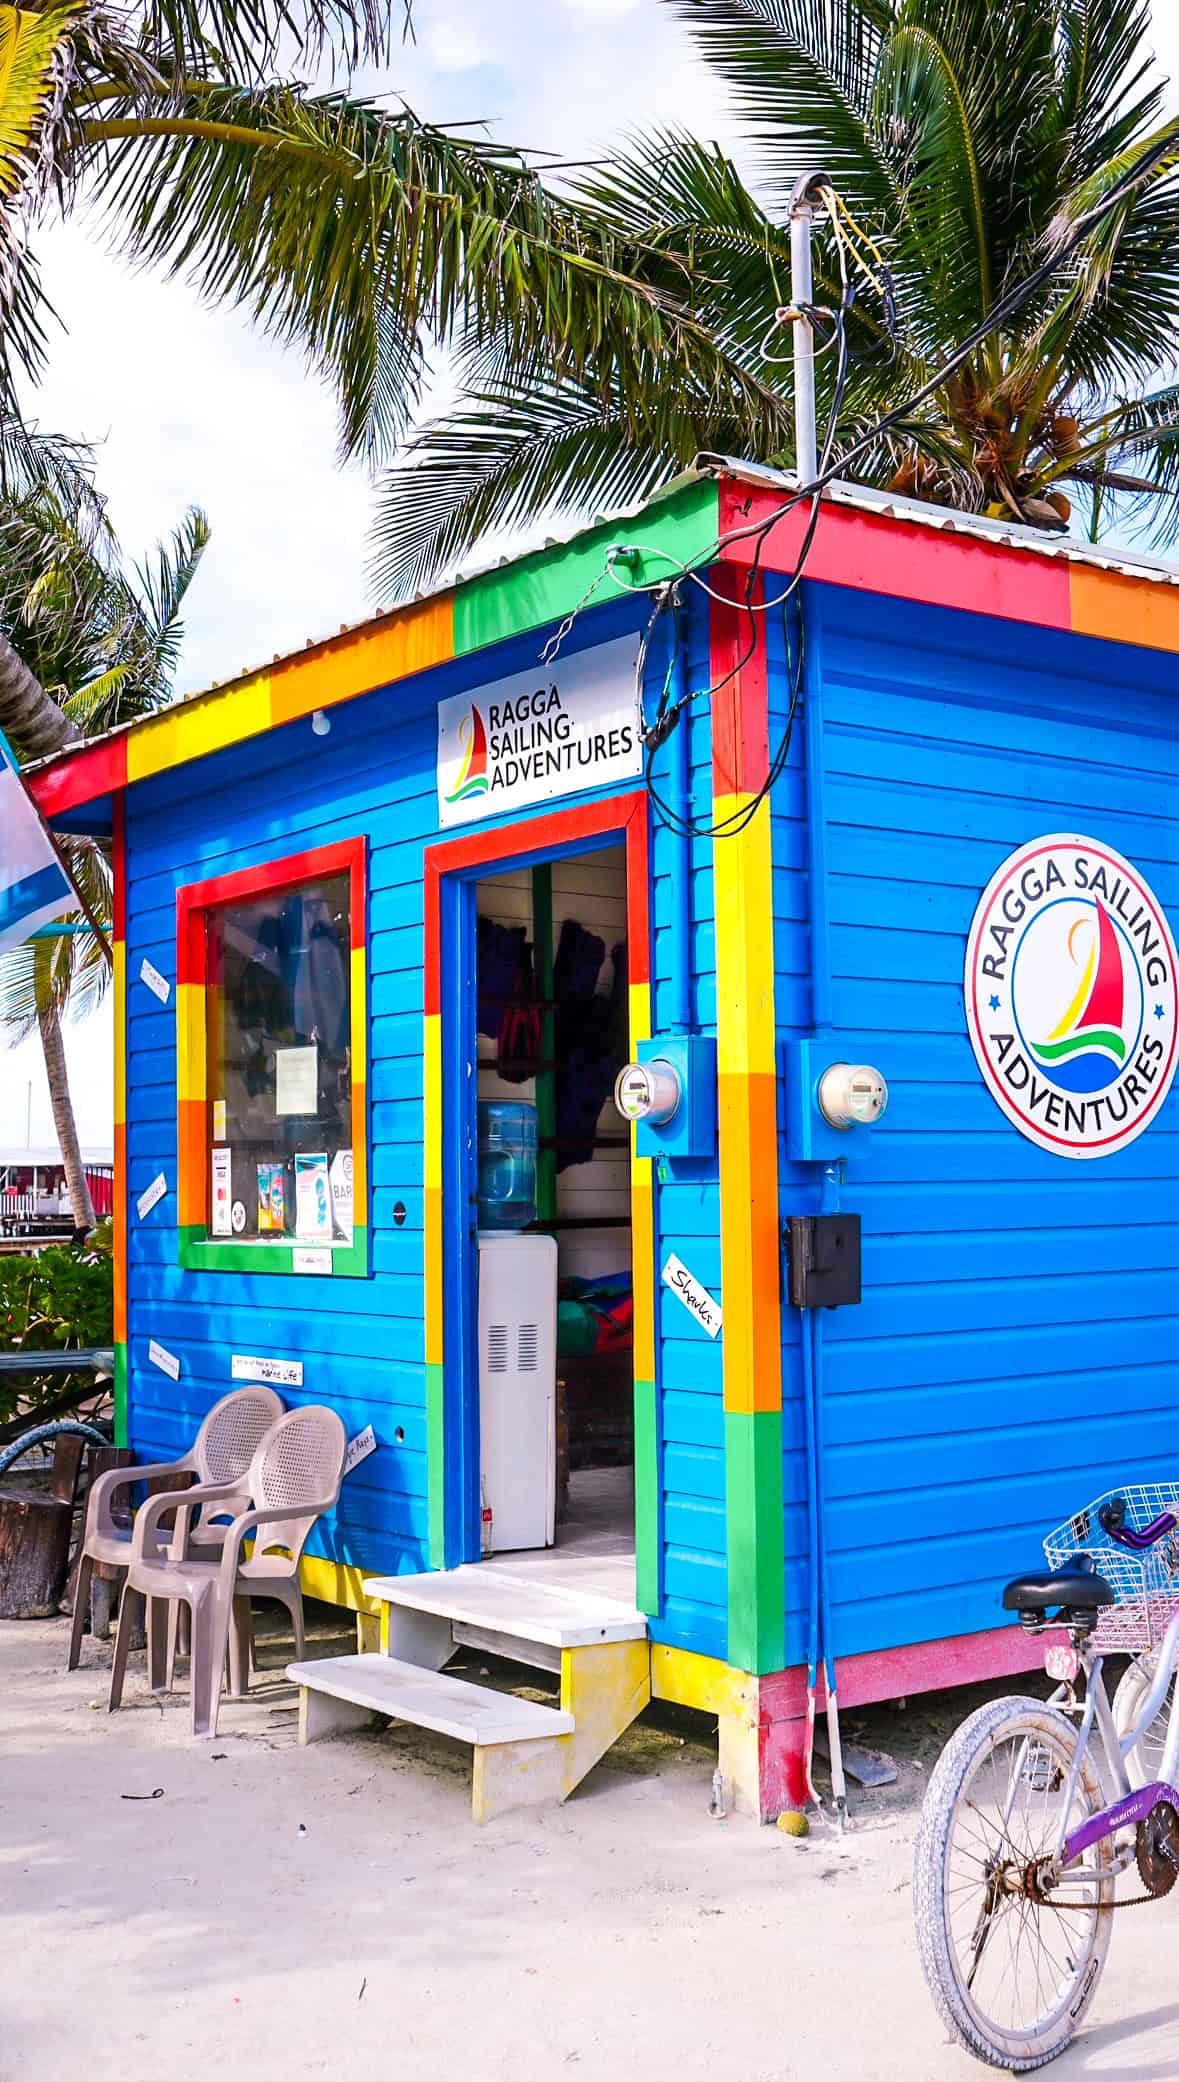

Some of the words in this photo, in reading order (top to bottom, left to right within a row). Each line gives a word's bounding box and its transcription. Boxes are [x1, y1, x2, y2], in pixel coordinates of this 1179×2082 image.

[489, 685, 561, 731] RAGGA
[490, 714, 570, 760] SAILING
[491, 726, 633, 792] ADVENTURES
[982, 858, 1066, 980] RAGGA
[1074, 857, 1167, 987] SAILING
[990, 1033, 1164, 1133] ADVENTURES
[671, 1270, 712, 1325] Sharks
